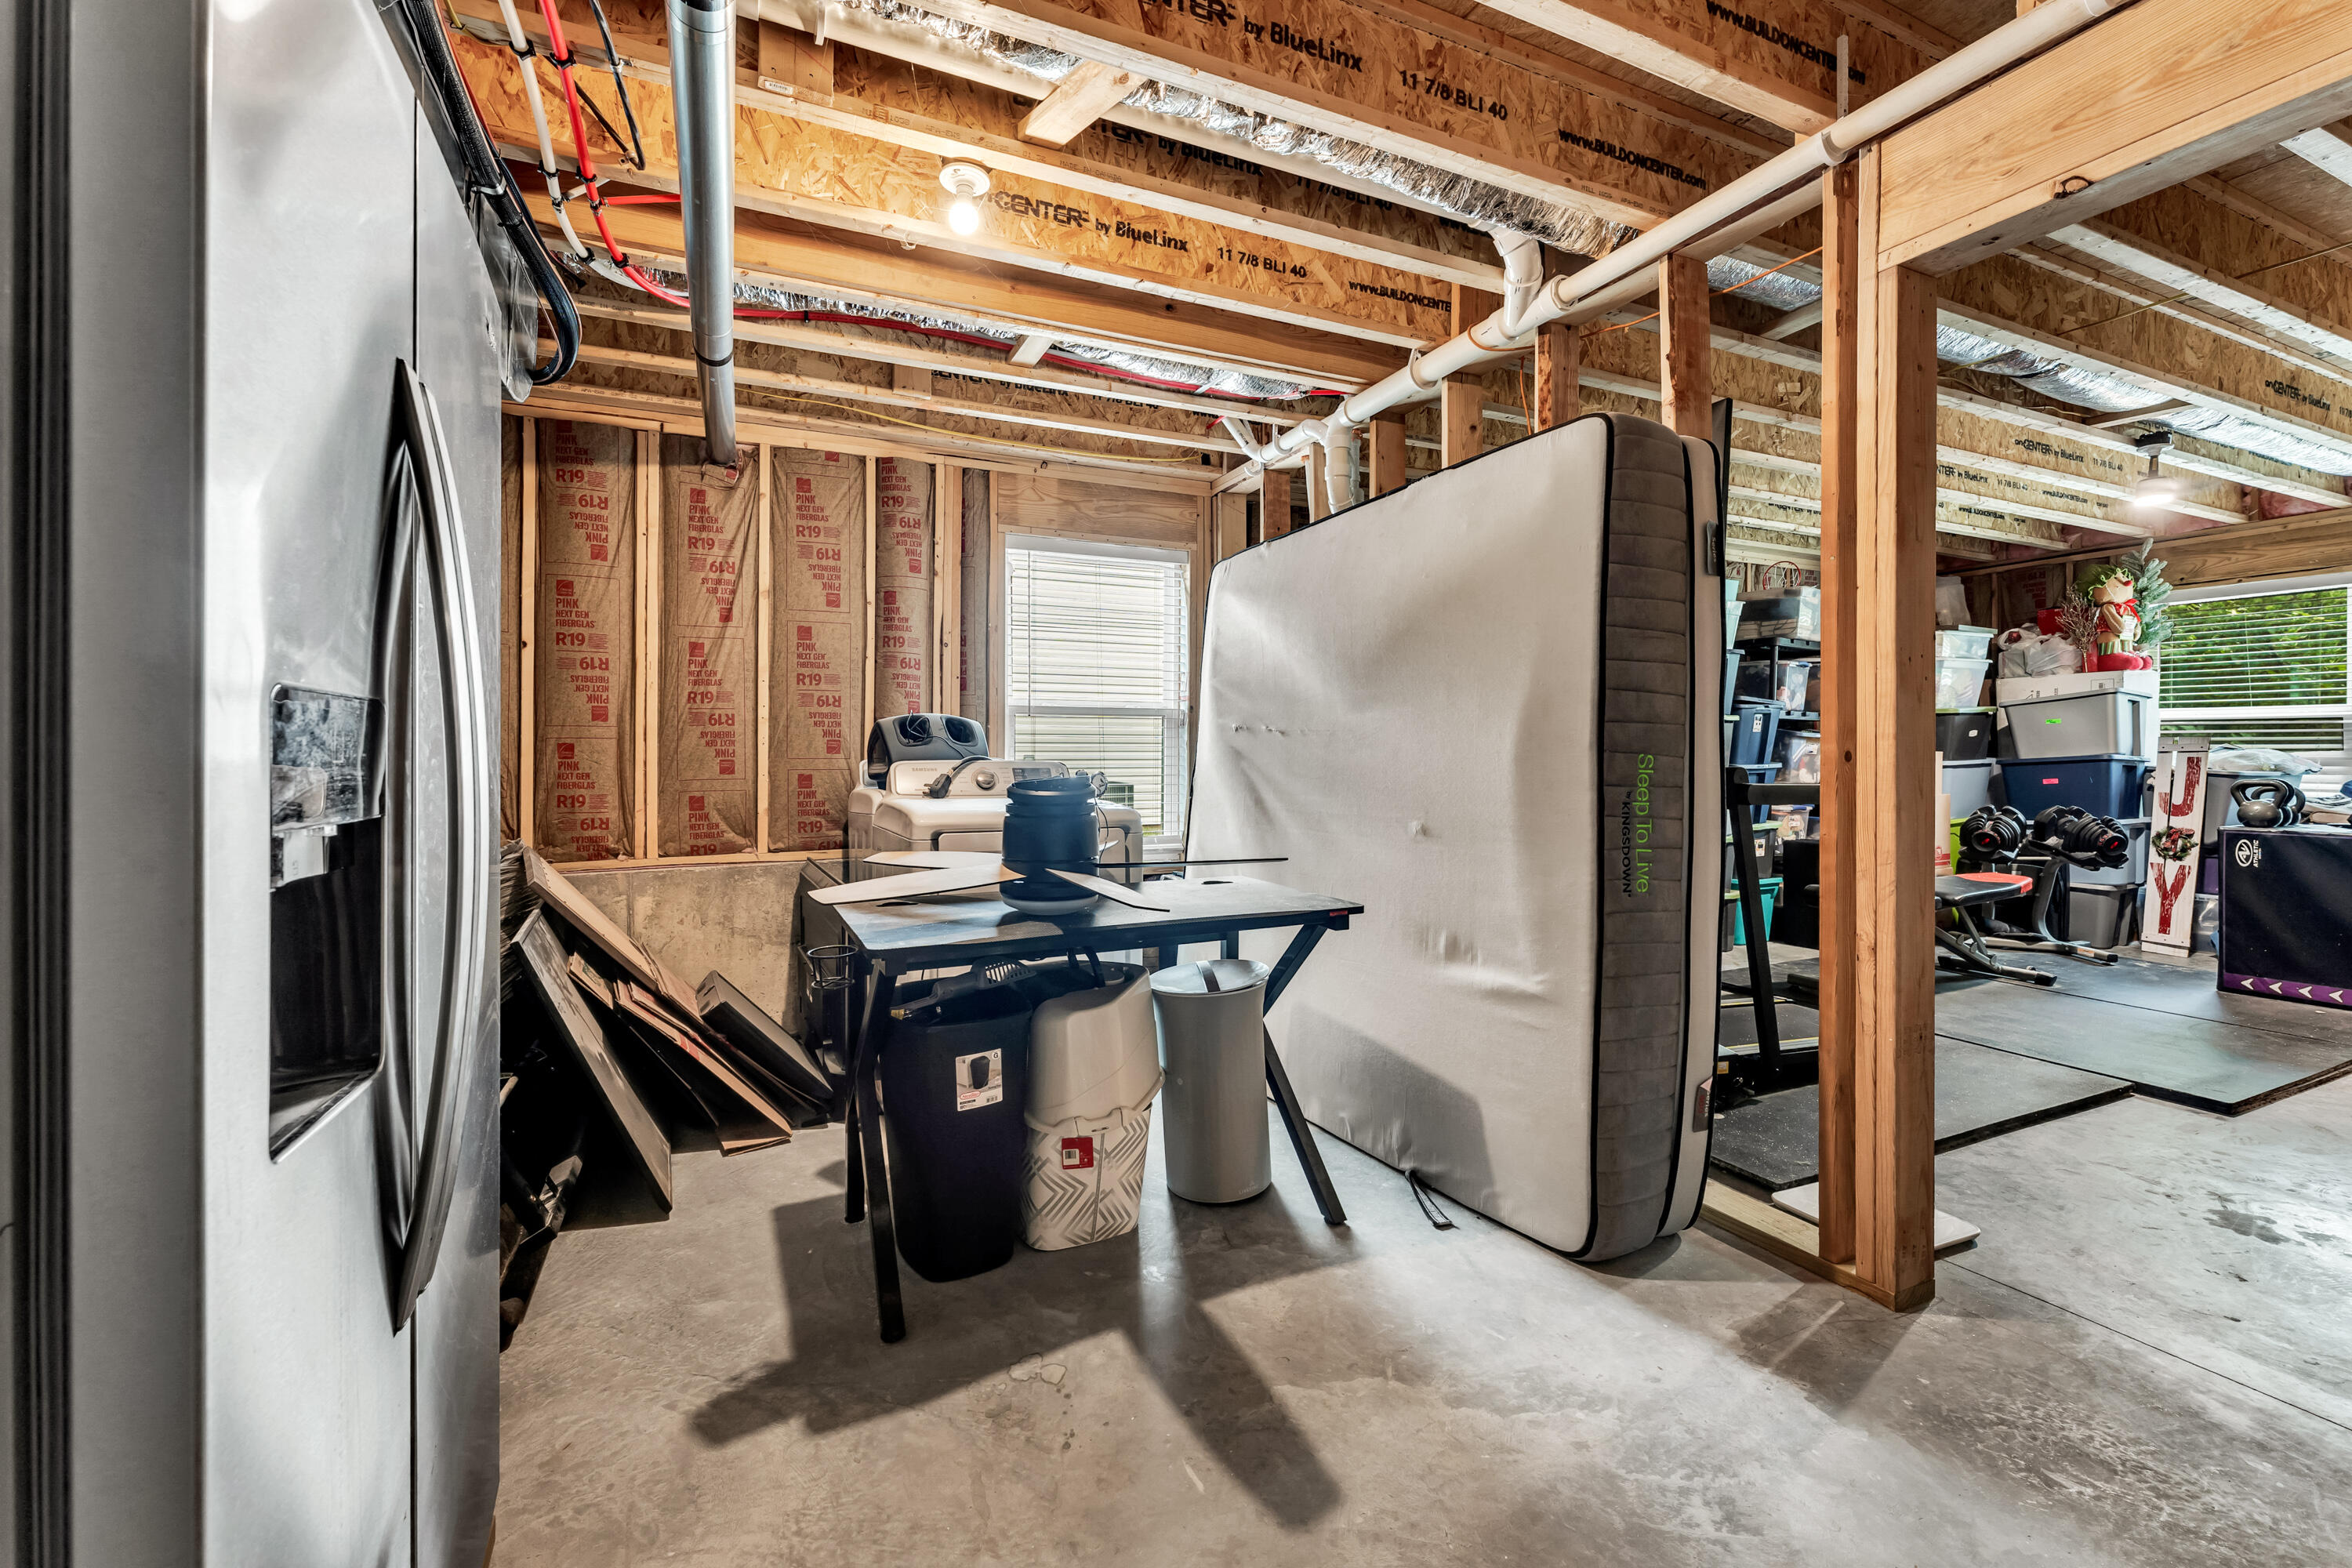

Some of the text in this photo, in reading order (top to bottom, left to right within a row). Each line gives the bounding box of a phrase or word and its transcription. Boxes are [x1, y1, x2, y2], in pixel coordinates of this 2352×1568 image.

[1244, 15, 1363, 72] by BlueLinx
[1399, 69, 1508, 121] 11 7/8 BLI 40
[1157, 135, 1263, 177] by BlueLinx
[1559, 127, 1707, 191] www.BUILDONCENTER.com
[1581, 185, 1595, 194] MILL
[1094, 218, 1110, 235] by
[1115, 221, 1189, 253] BlueLinx
[1217, 247, 1308, 279] 11 7/8 BLI 40
[2302, 395, 2307, 405] by
[2308, 394, 2331, 411] BlueLinx
[574, 447, 589, 456] GEN
[2060, 448, 2084, 463] BlueLinx
[556, 468, 585, 483] R19
[881, 465, 898, 474] PINK
[1964, 470, 1988, 484] BlueLinx
[579, 495, 608, 510] R19
[796, 494, 815, 504] PINK
[881, 495, 904, 508] R19
[689, 505, 710, 514] PINK
[688, 515, 718, 524] NEXT GEN
[899, 516, 921, 529] R19
[591, 523, 608, 532] NEXT
[796, 525, 822, 538] R19
[586, 532, 608, 543] PINK
[688, 536, 715, 550] R19
[816, 548, 840, 561] R19
[906, 548, 922, 558] PINK
[709, 561, 735, 574] R19
[720, 587, 735, 596] NEXT
[822, 582, 840, 591] PINK
[556, 598, 579, 608] PINK
[883, 606, 901, 615] PINK
[556, 633, 586, 646] R19
[883, 636, 906, 648] R19
[797, 641, 816, 652] PINK
[579, 657, 608, 670] R19
[688, 659, 708, 669] PINK
[900, 657, 921, 670] R19
[797, 673, 822, 686] R19
[575, 684, 590, 692] GEN
[586, 694, 608, 704] PINK
[688, 691, 713, 704] R19
[904, 690, 920, 699] PINK
[817, 695, 841, 707] R19
[709, 713, 735, 726] R19
[822, 729, 841, 739] PINK
[715, 748, 735, 757] PINK
[557, 760, 579, 771] PINK
[797, 789, 817, 800] PINK
[557, 794, 586, 808] R19
[688, 812, 710, 822] PINK
[1632, 753, 1654, 893] Sleep To Live
[580, 818, 609, 830] R19
[797, 820, 823, 833] R19
[690, 844, 717, 856] R19
[1621, 801, 1632, 897] KINGSDOWN
